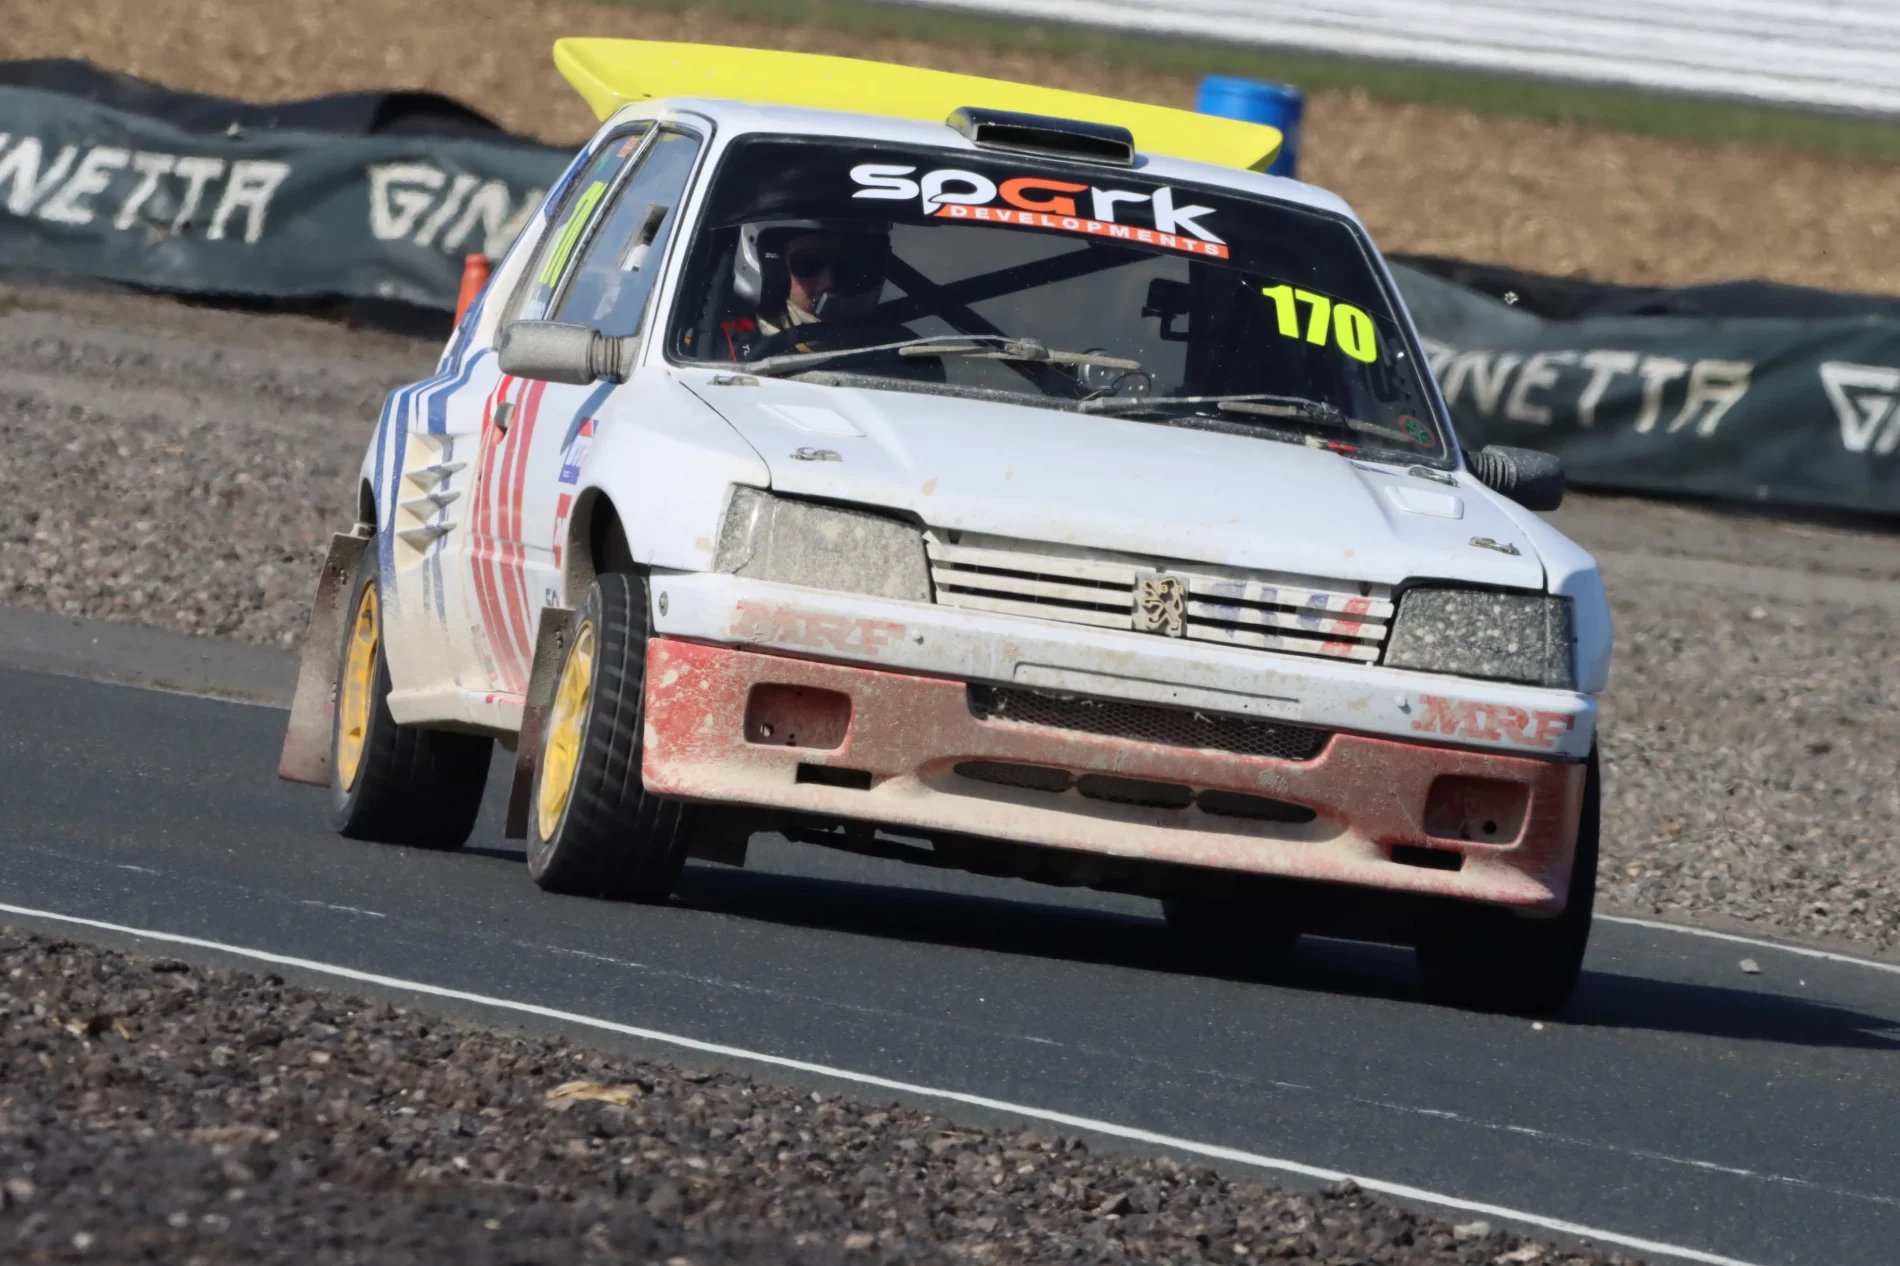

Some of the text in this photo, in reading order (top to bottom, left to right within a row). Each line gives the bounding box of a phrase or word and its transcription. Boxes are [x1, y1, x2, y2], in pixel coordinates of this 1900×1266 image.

[0, 132, 290, 243] NETTA
[951, 205, 1221, 256] DEVELOPMENTS
[1262, 284, 1377, 363] 170
[1419, 336, 1753, 437] NETTA
[728, 599, 907, 657] MRF
[1411, 693, 1576, 748] MRF
